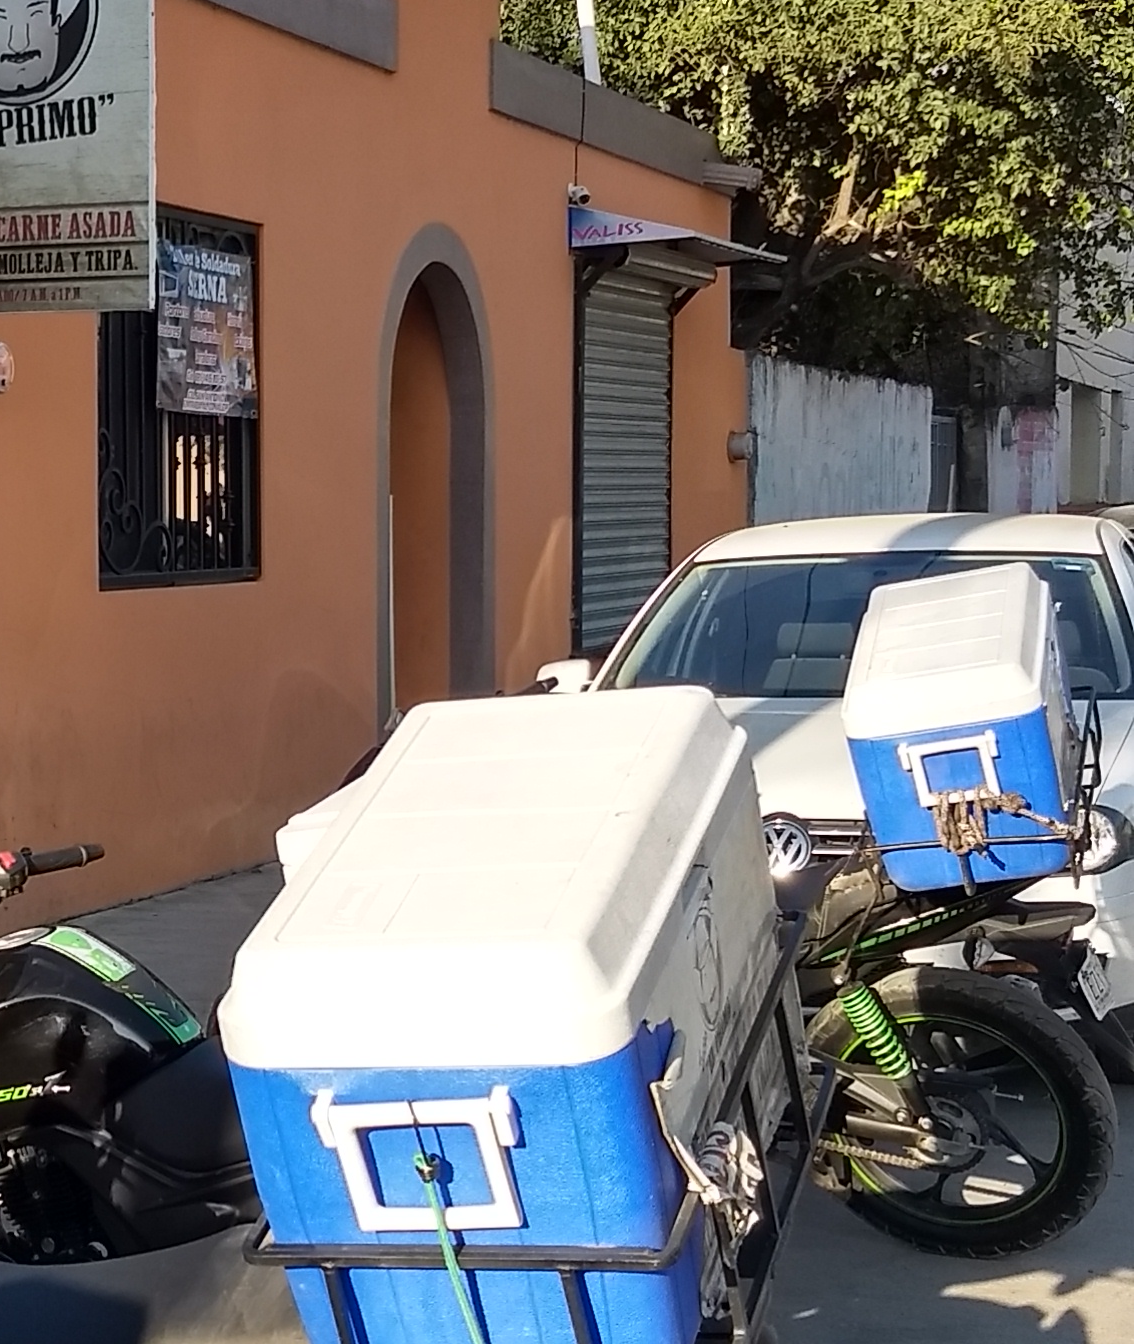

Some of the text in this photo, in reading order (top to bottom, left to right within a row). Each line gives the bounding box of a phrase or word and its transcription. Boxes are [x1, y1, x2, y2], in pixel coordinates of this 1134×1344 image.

[67, 209, 137, 240] ASADA
[572, 221, 644, 241] VALISS
[70, 251, 81, 273] Y
[85, 248, 139, 272] TRIPA.
